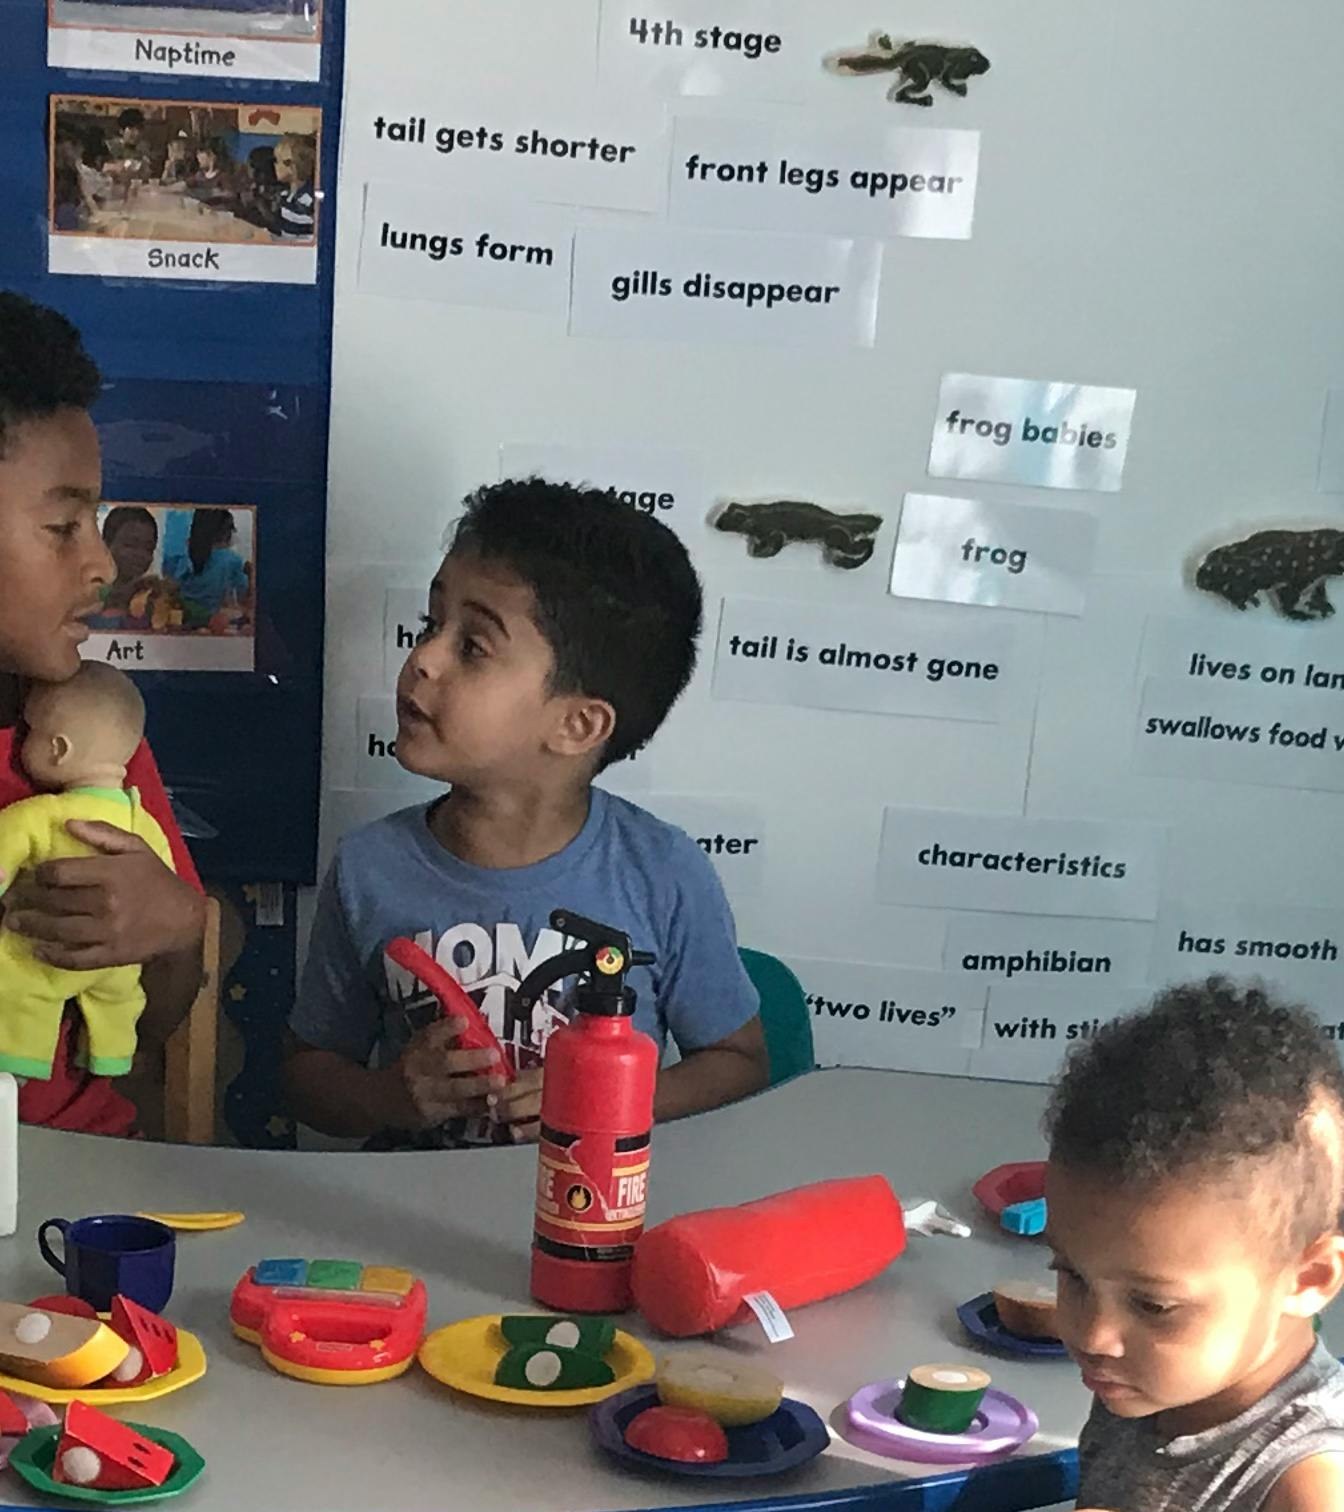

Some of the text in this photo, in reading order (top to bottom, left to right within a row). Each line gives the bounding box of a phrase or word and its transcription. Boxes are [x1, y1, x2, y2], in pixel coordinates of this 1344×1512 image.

[135, 38, 236, 69] Naptime
[629, 17, 782, 59] 4th stage
[373, 116, 636, 163] tail gets shorter
[685, 154, 964, 201] front legs appear
[147, 247, 220, 270] Snack
[381, 222, 553, 266] lungs form
[611, 270, 841, 309] gills disappear
[945, 409, 1117, 451] frog babies
[611, 487, 675, 515] age
[961, 538, 1028, 575] frog
[106, 639, 145, 661] Art
[729, 635, 999, 682] tail is almost gone
[1188, 652, 1251, 681] lives
[1260, 666, 1296, 685] on
[1145, 715, 1261, 744] swallows
[1268, 722, 1328, 750] food
[696, 831, 758, 856] ater
[918, 843, 1126, 879] characteristics
[1178, 930, 1226, 955] has
[1234, 938, 1338, 961] smooth
[962, 949, 1112, 978] amphibian
[993, 1016, 1107, 1041] with sti
[617, 1173, 647, 1207] FIRE
